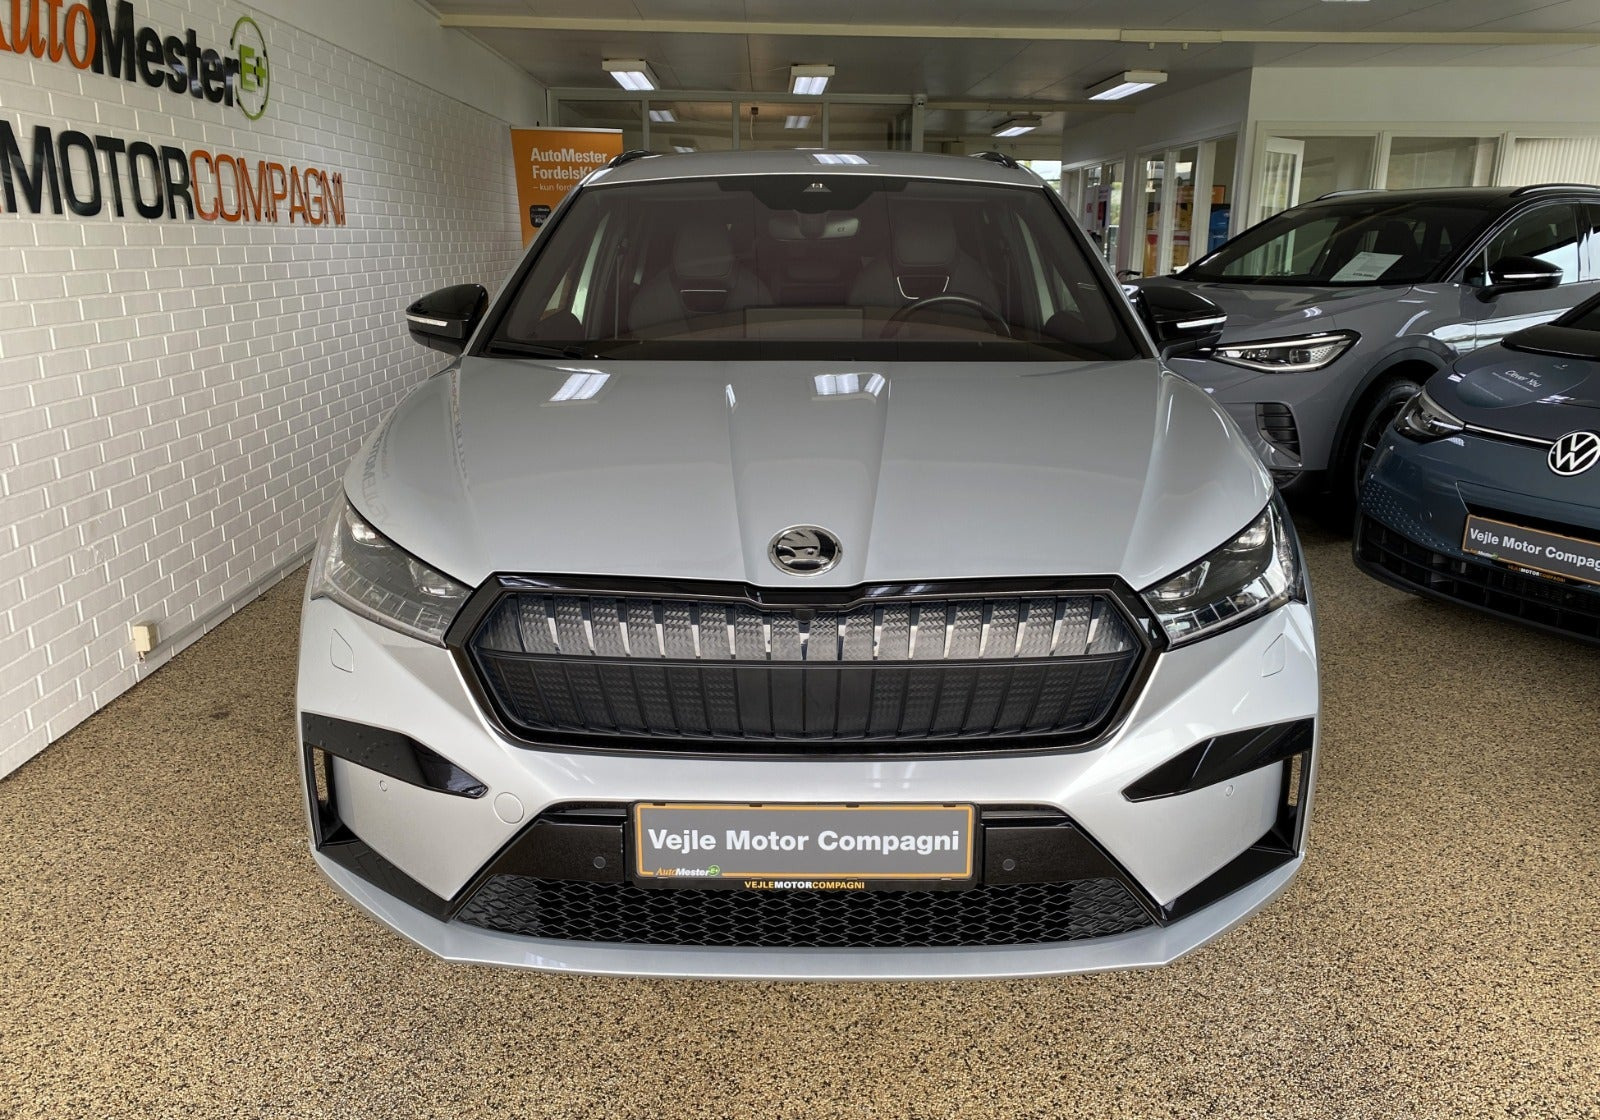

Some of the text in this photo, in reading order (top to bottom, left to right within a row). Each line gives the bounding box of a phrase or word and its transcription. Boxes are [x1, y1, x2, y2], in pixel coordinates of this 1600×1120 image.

[0, 0, 242, 107] utoMester
[530, 148, 608, 163] AutoMester
[539, 183, 555, 192] kun
[1470, 528, 1500, 545] Vejle
[1502, 535, 1543, 555] Motor
[648, 829, 959, 855] Vejle Motor Compagni
[656, 867, 710, 877] AutoMester
[744, 881, 866, 889] VEJLEMOTORCOMPAGNI
